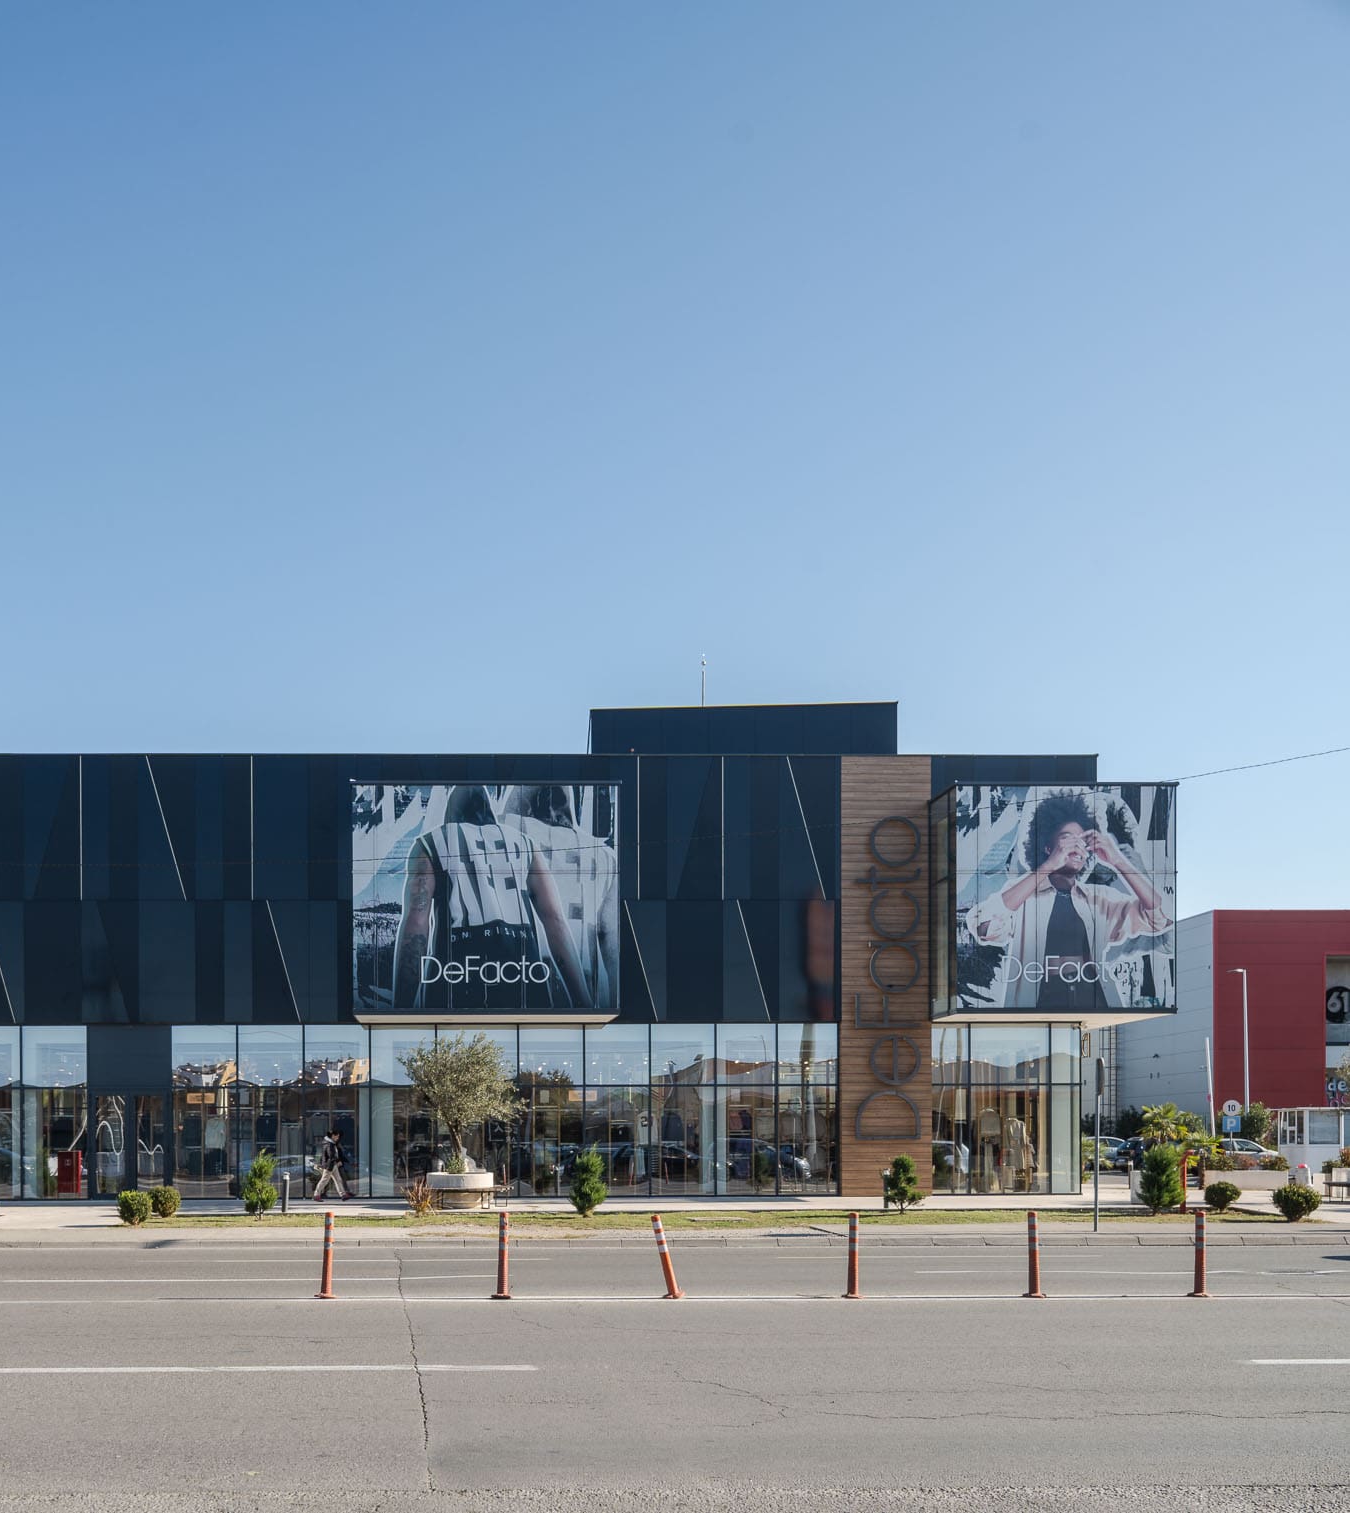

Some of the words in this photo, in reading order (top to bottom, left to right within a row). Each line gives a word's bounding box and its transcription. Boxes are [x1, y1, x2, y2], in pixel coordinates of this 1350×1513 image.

[421, 955, 549, 983] DeFacto
[855, 816, 921, 1140] DeFacto
[1001, 955, 1129, 983] DeFacto
[1227, 1104, 1237, 1112] 10
[1226, 1118, 1237, 1130] P
